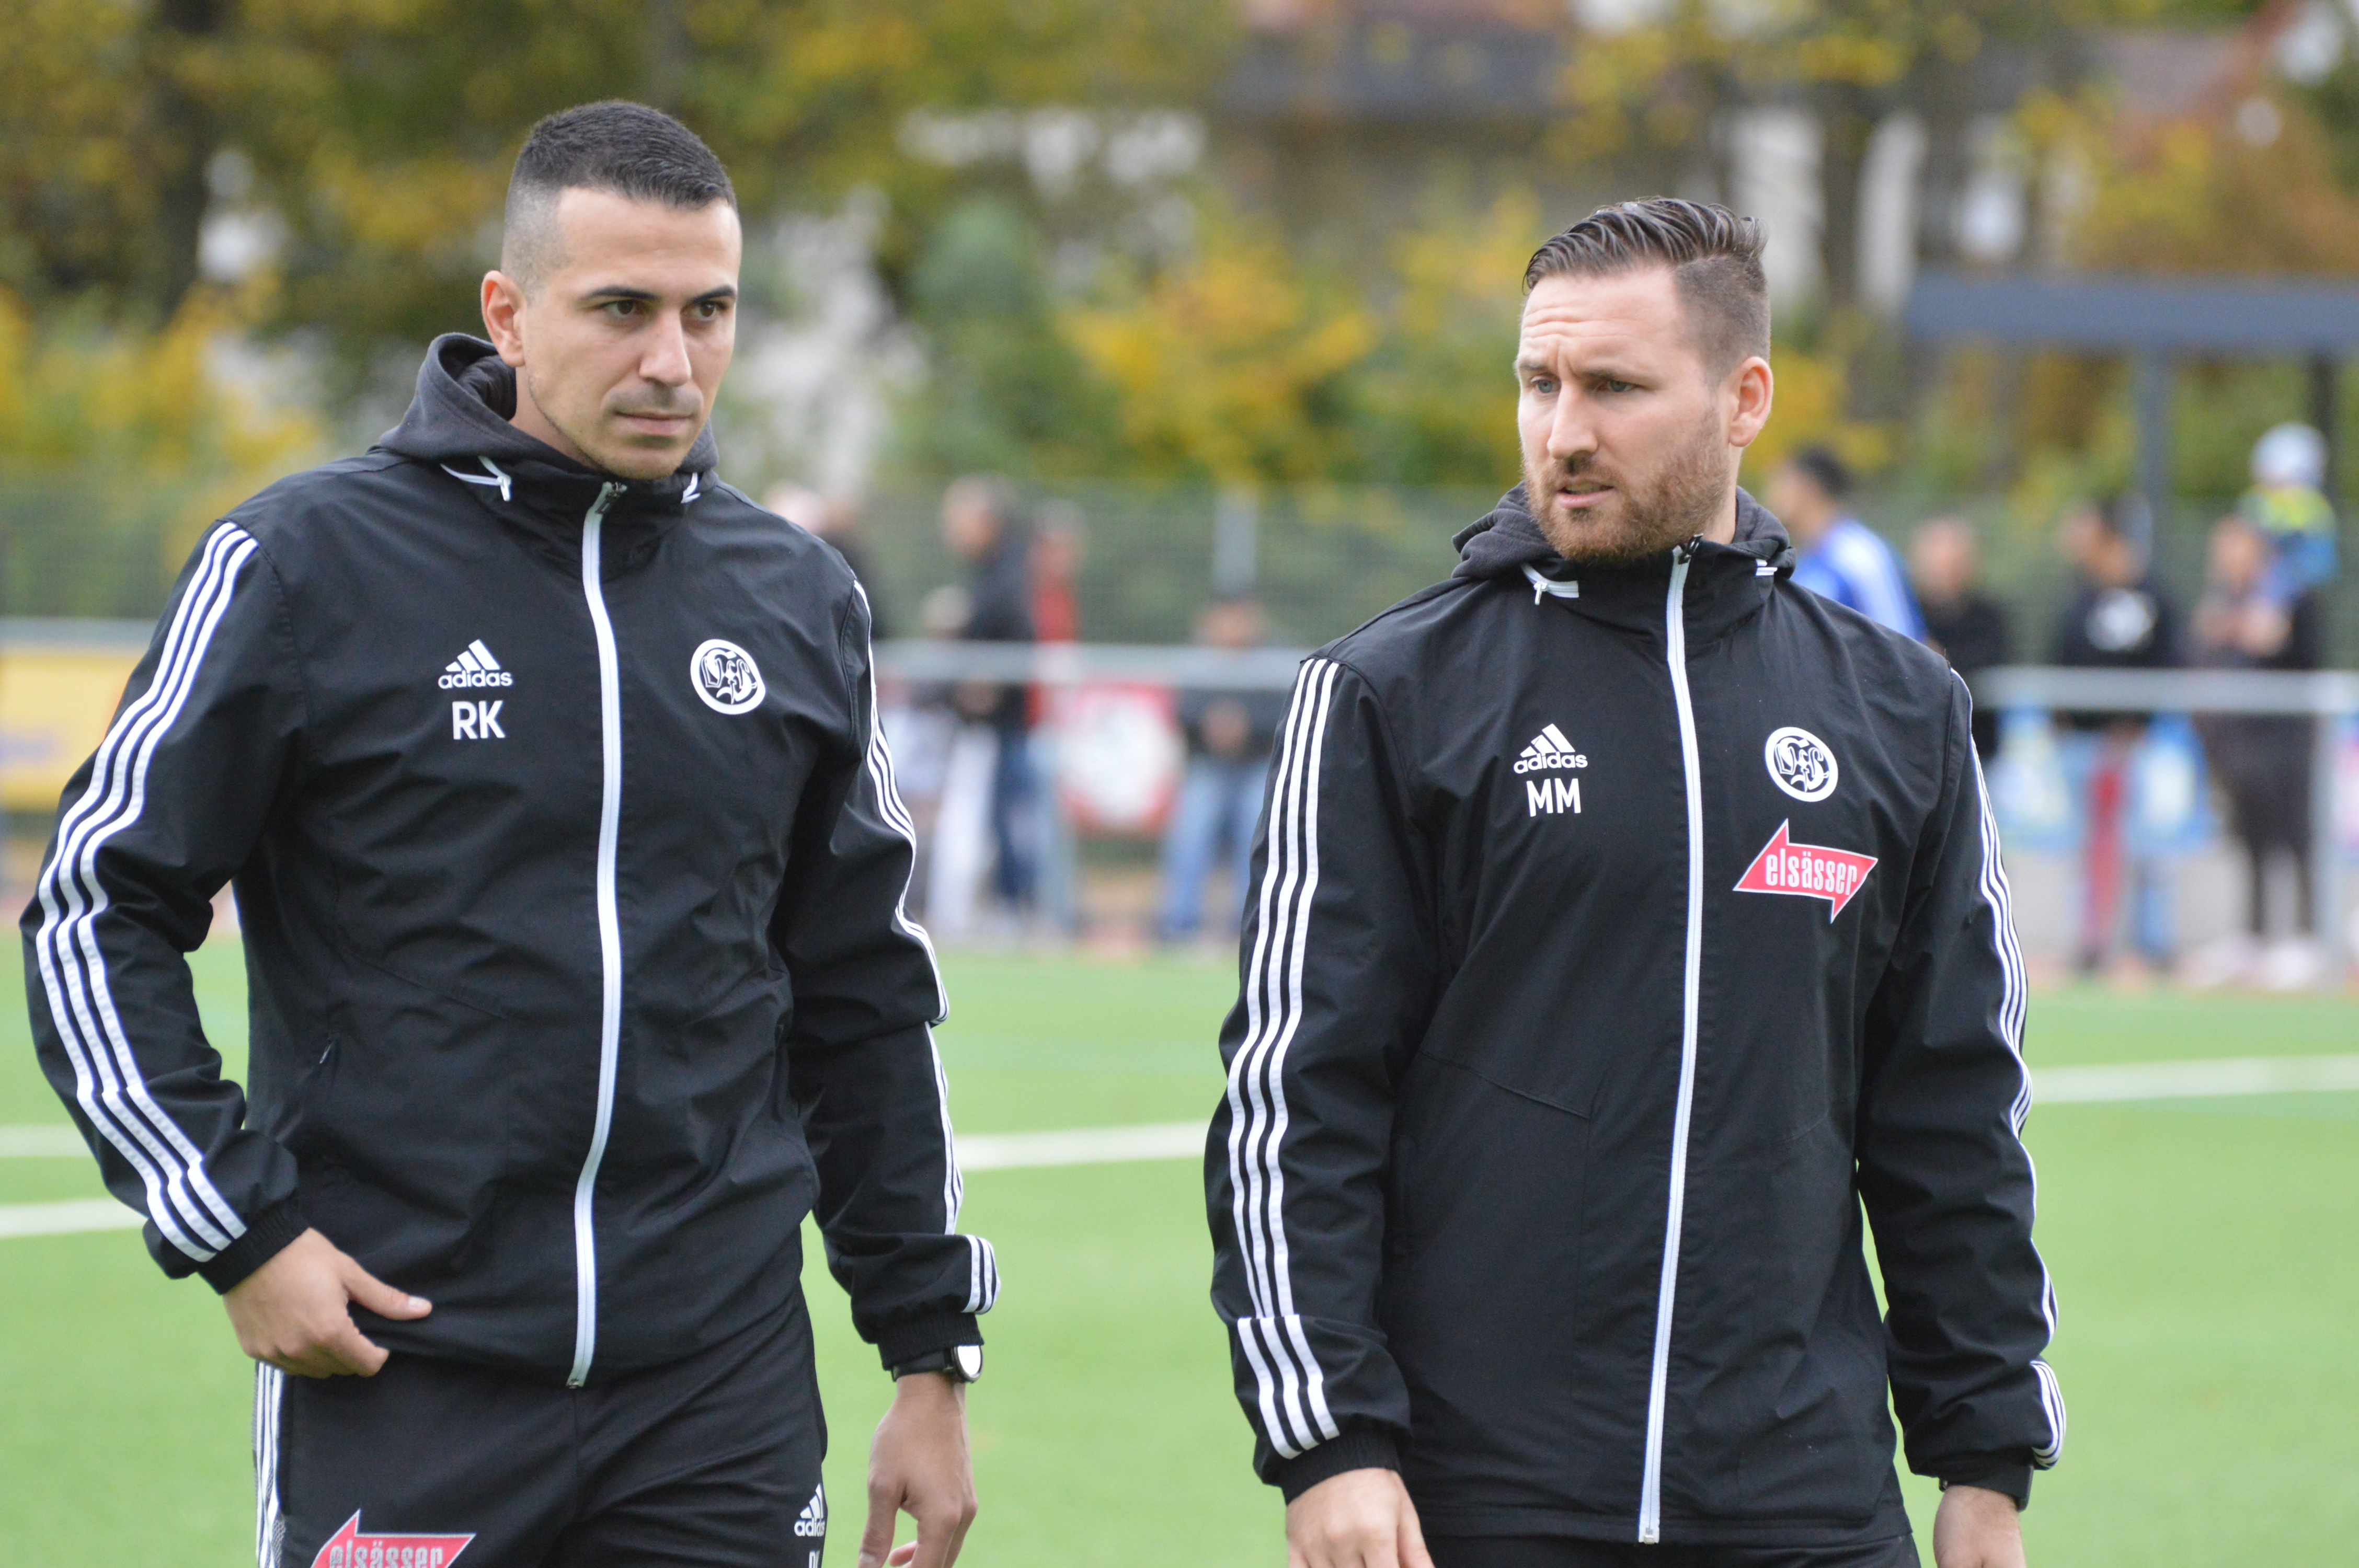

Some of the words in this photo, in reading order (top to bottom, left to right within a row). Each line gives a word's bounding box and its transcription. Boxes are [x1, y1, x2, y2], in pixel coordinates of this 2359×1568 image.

[438, 670, 513, 689] adidas
[452, 700, 506, 740] RK
[1513, 751, 1588, 774] adidas
[1526, 778, 1581, 817] MM
[1765, 848, 1858, 896] elsässer
